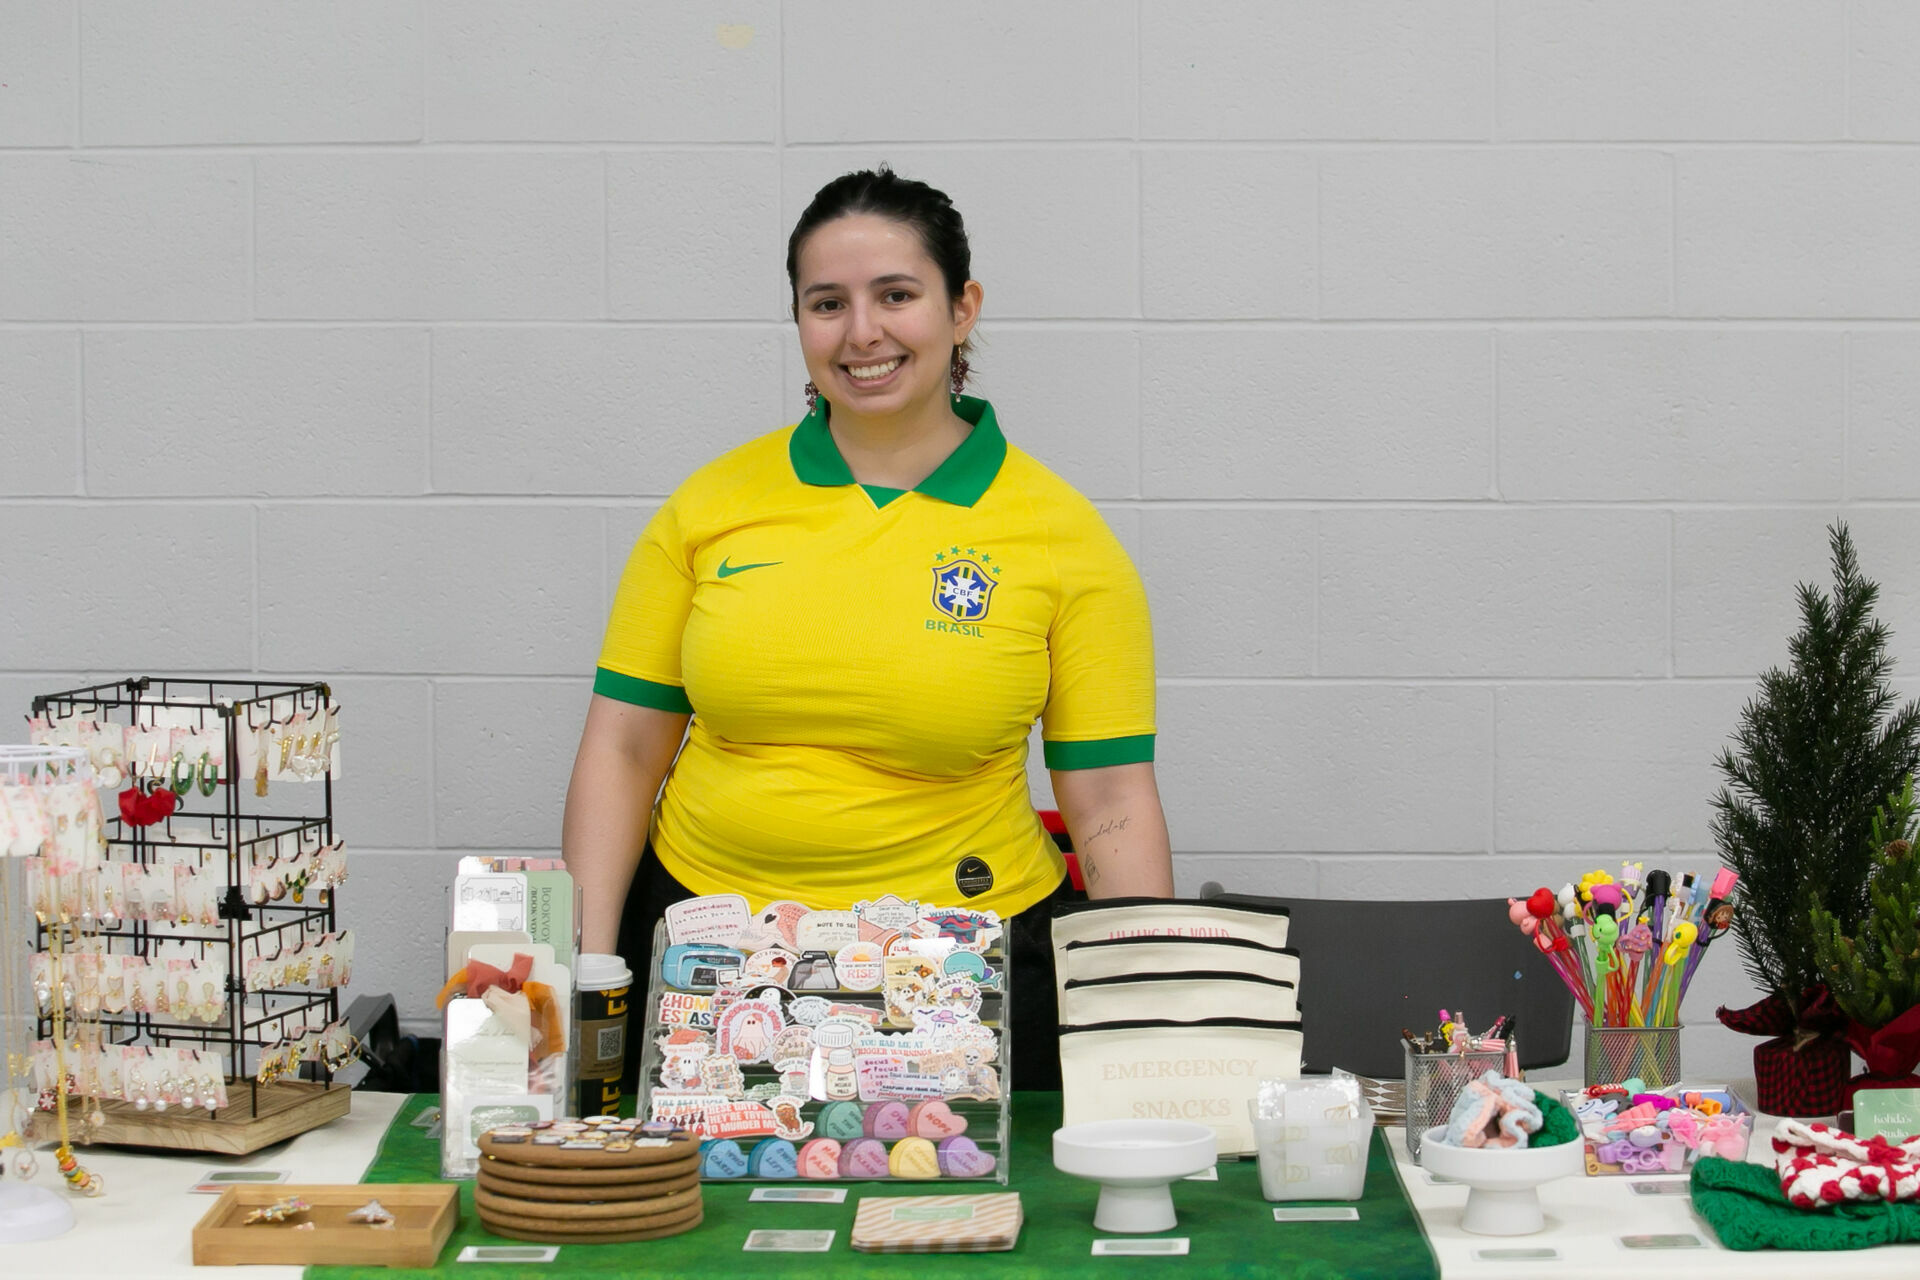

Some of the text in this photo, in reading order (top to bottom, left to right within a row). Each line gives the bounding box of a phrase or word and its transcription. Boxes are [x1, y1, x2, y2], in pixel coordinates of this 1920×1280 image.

[952, 587, 974, 597] CBF
[925, 619, 985, 638] BRASIL
[969, 912, 989, 923] LIKE
[847, 968, 876, 979] RISE
[662, 993, 711, 1011] ¿HOM
[661, 1008, 711, 1026] ESTAS
[860, 1039, 924, 1049] YOU HAD ME AT
[890, 1048, 933, 1057] WARNINGS
[1101, 1058, 1259, 1081] EMERGENCY
[877, 1090, 945, 1100] poltergeist mode
[743, 1110, 773, 1120] TRYIN
[1131, 1097, 1232, 1120] SNACKS
[721, 1120, 760, 1133] MURDER
[882, 1122, 894, 1131] IT
[925, 1112, 952, 1134] NOPE
[710, 1154, 736, 1176] CARES
[725, 1149, 745, 1168] WHO
[765, 1156, 785, 1173] LEFT
[853, 1153, 879, 1176] PLEASE
[868, 1151, 886, 1168] NEXT
[966, 1151, 978, 1162] NO
[809, 1155, 833, 1176] PASS
